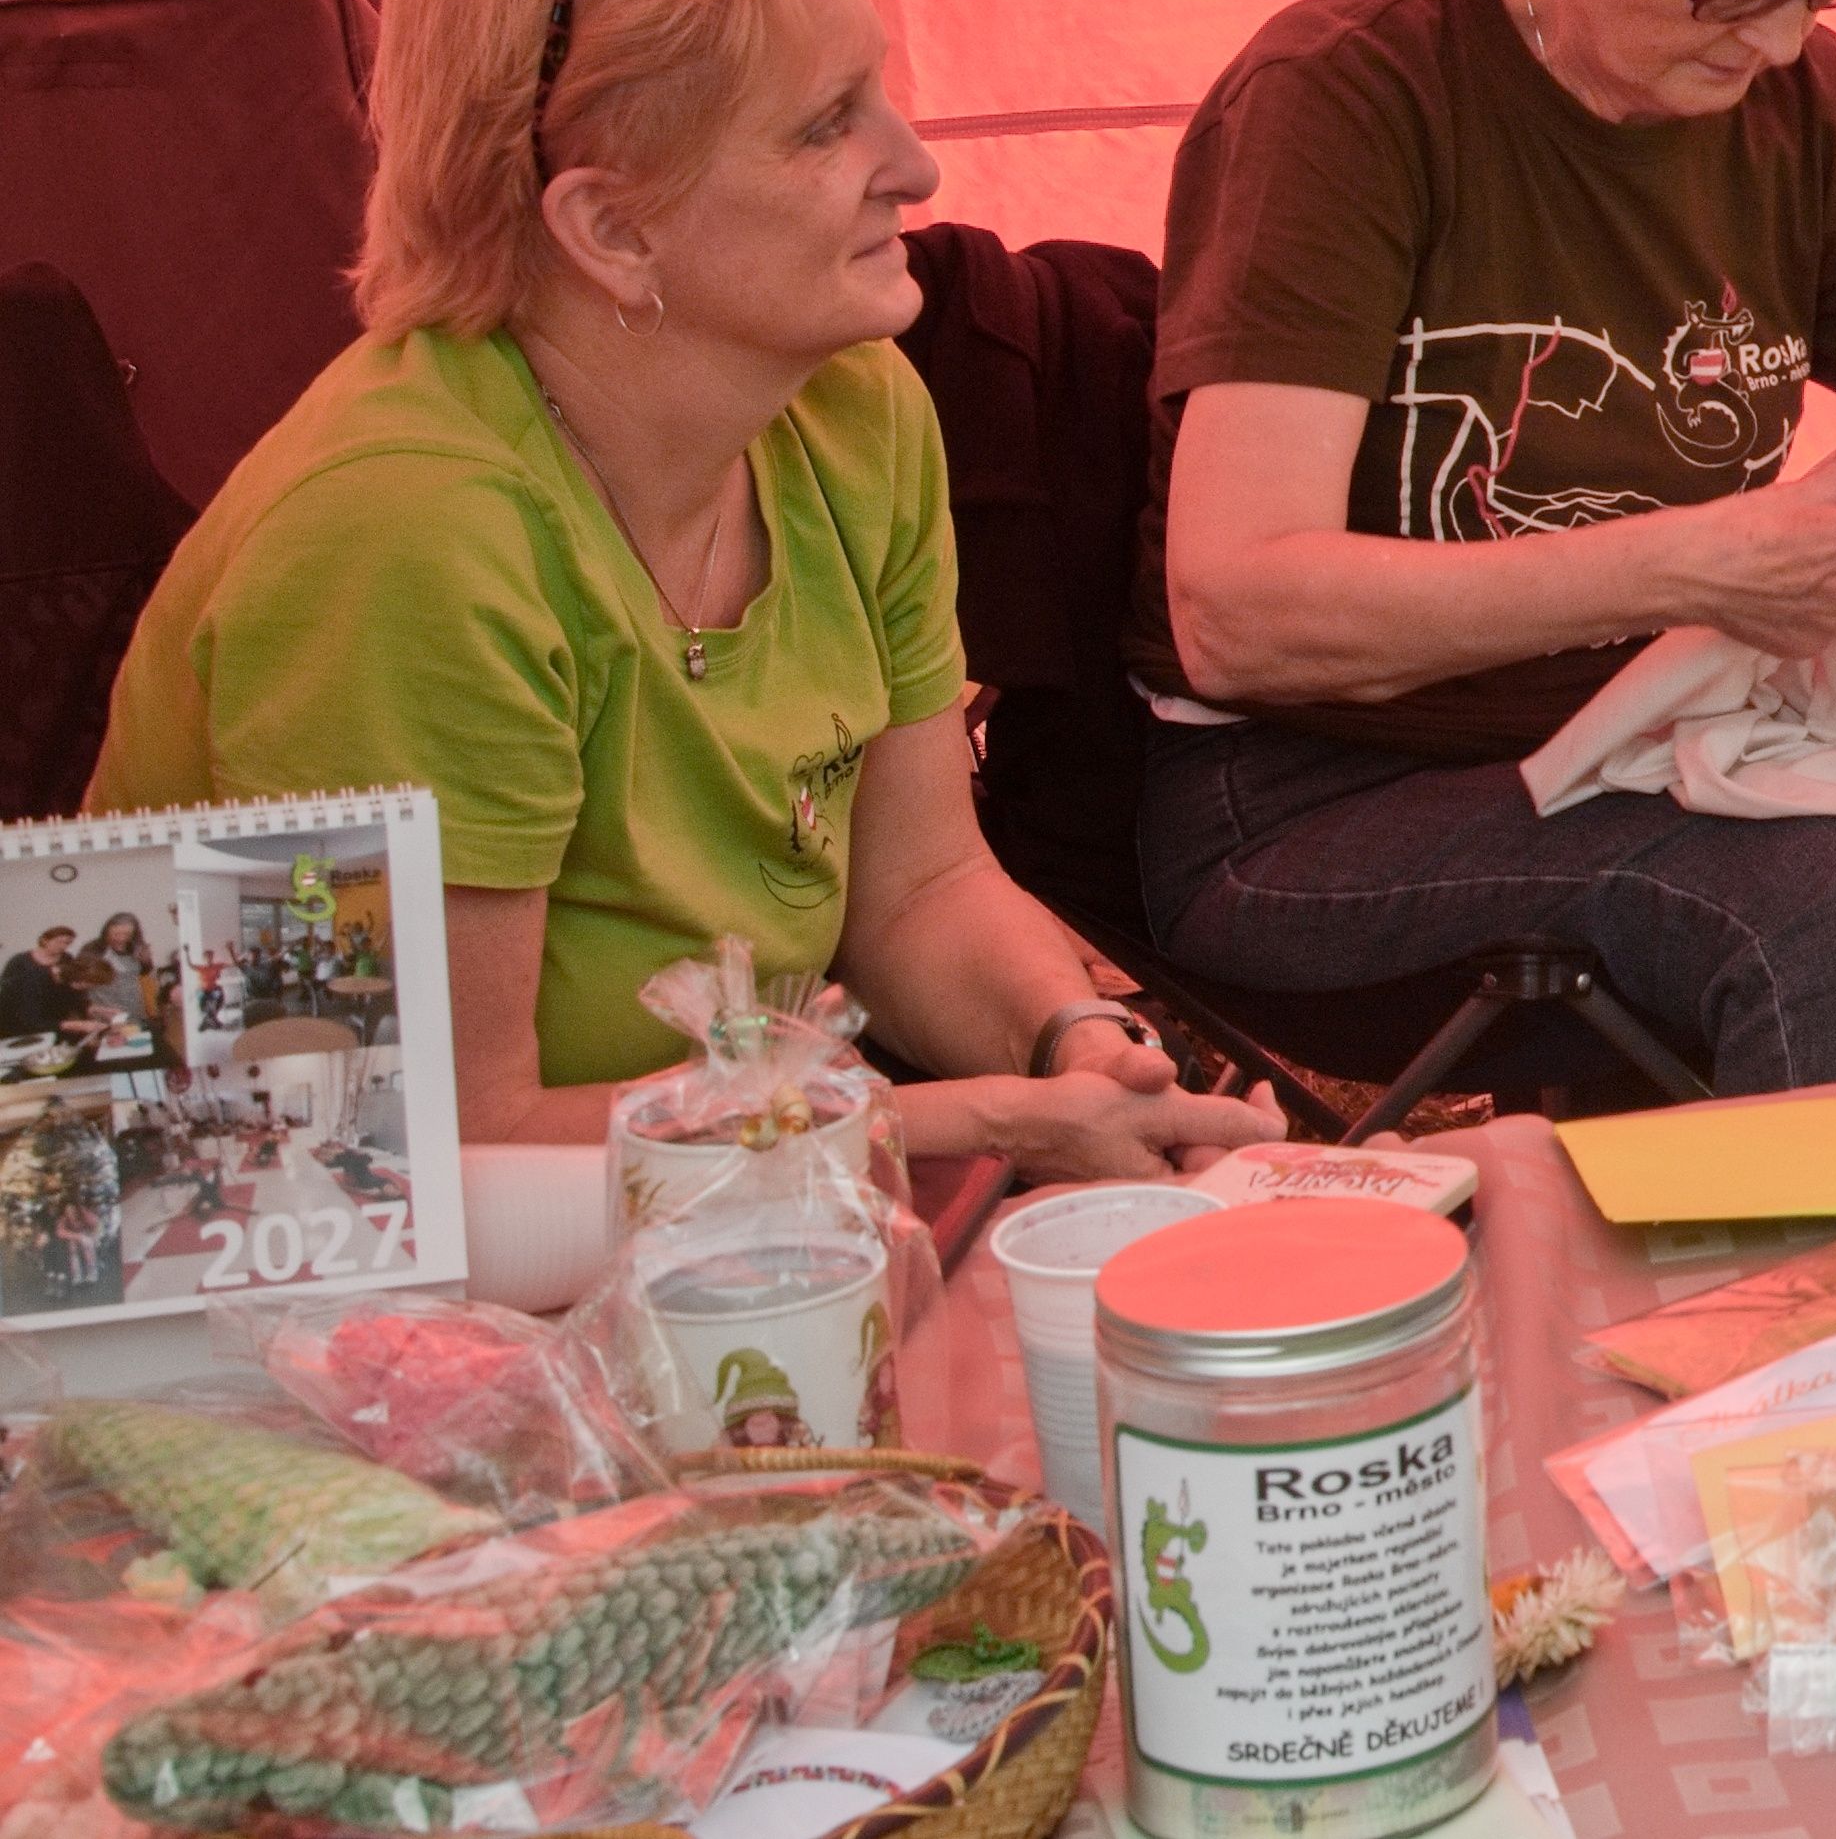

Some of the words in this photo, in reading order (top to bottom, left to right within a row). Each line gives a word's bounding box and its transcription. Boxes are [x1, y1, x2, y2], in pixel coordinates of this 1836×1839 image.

[1746, 373, 1779, 391] Brno
[200, 1199, 409, 1290] 2027
[1256, 1432, 1454, 1502] Roska
[1256, 1502, 1342, 1523] Brno
[1375, 1462, 1456, 1506] město
[1227, 1727, 1354, 1764] SRDEČNĚ
[1366, 1683, 1477, 1753] DĚKUJEME
